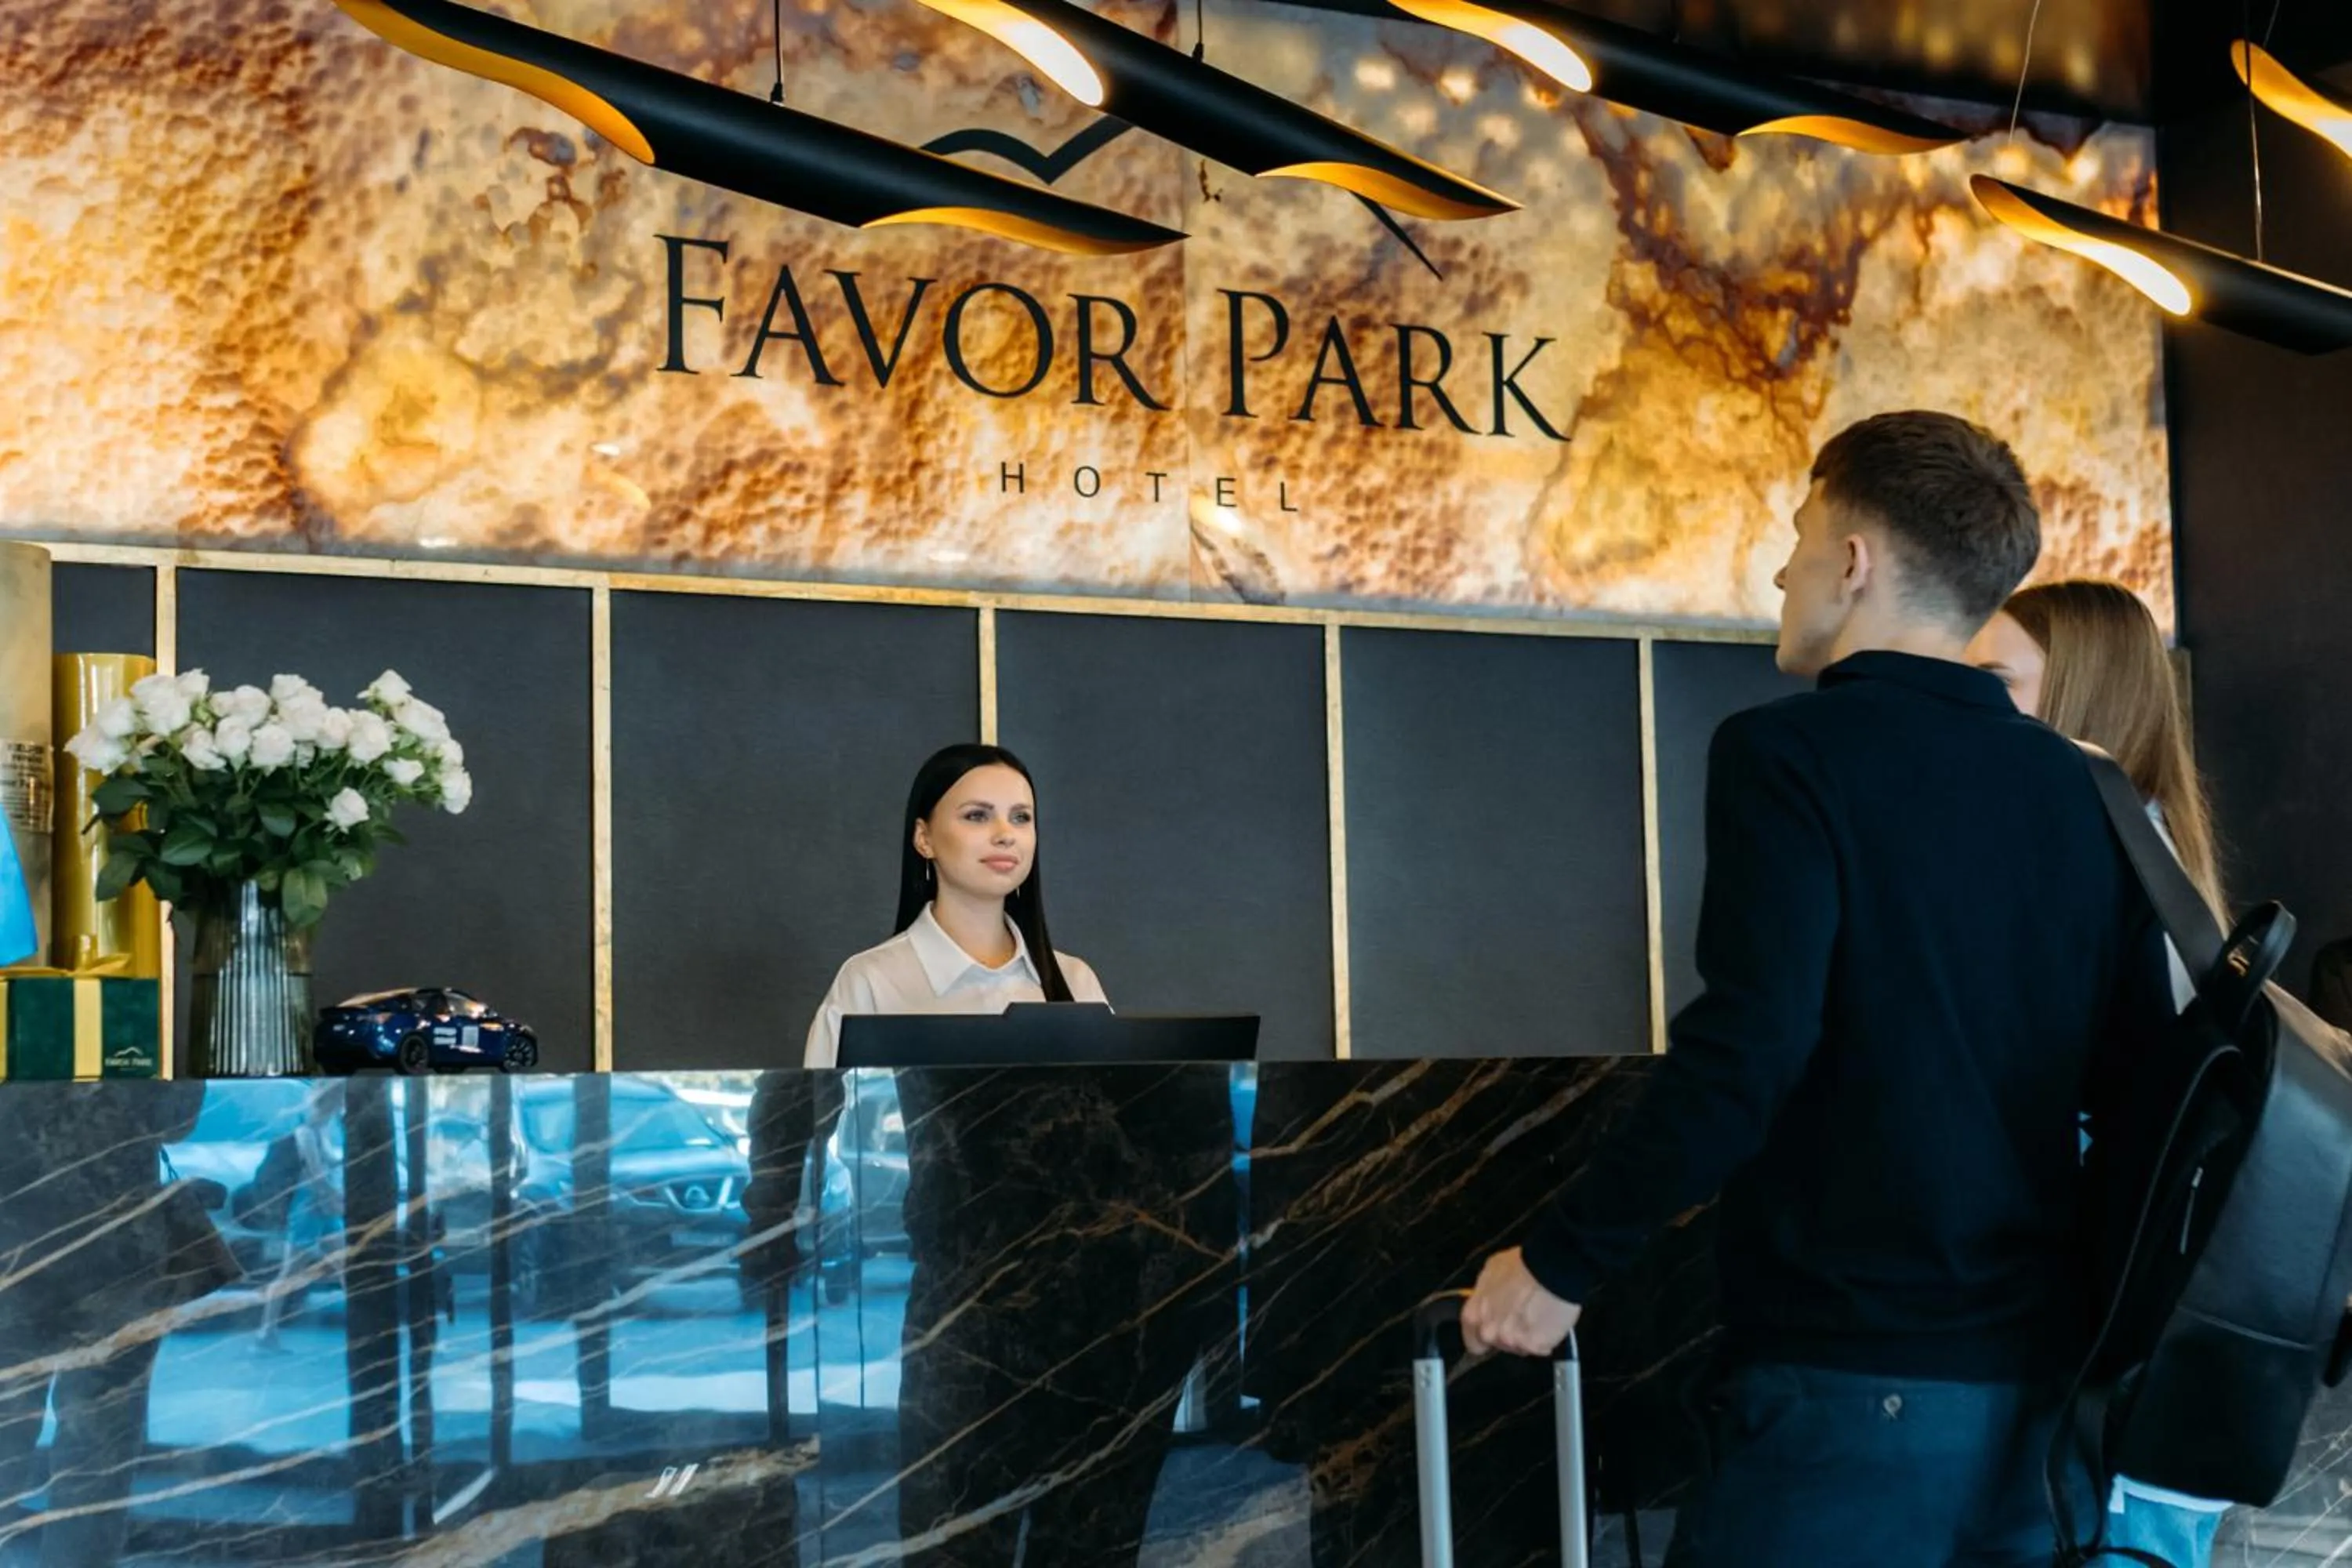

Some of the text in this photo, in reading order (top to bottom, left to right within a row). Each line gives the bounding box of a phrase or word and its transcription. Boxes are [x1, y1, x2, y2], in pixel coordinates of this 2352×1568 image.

[654, 234, 1571, 441] FAVOR PARK
[1000, 462, 1298, 512] HOTEL
